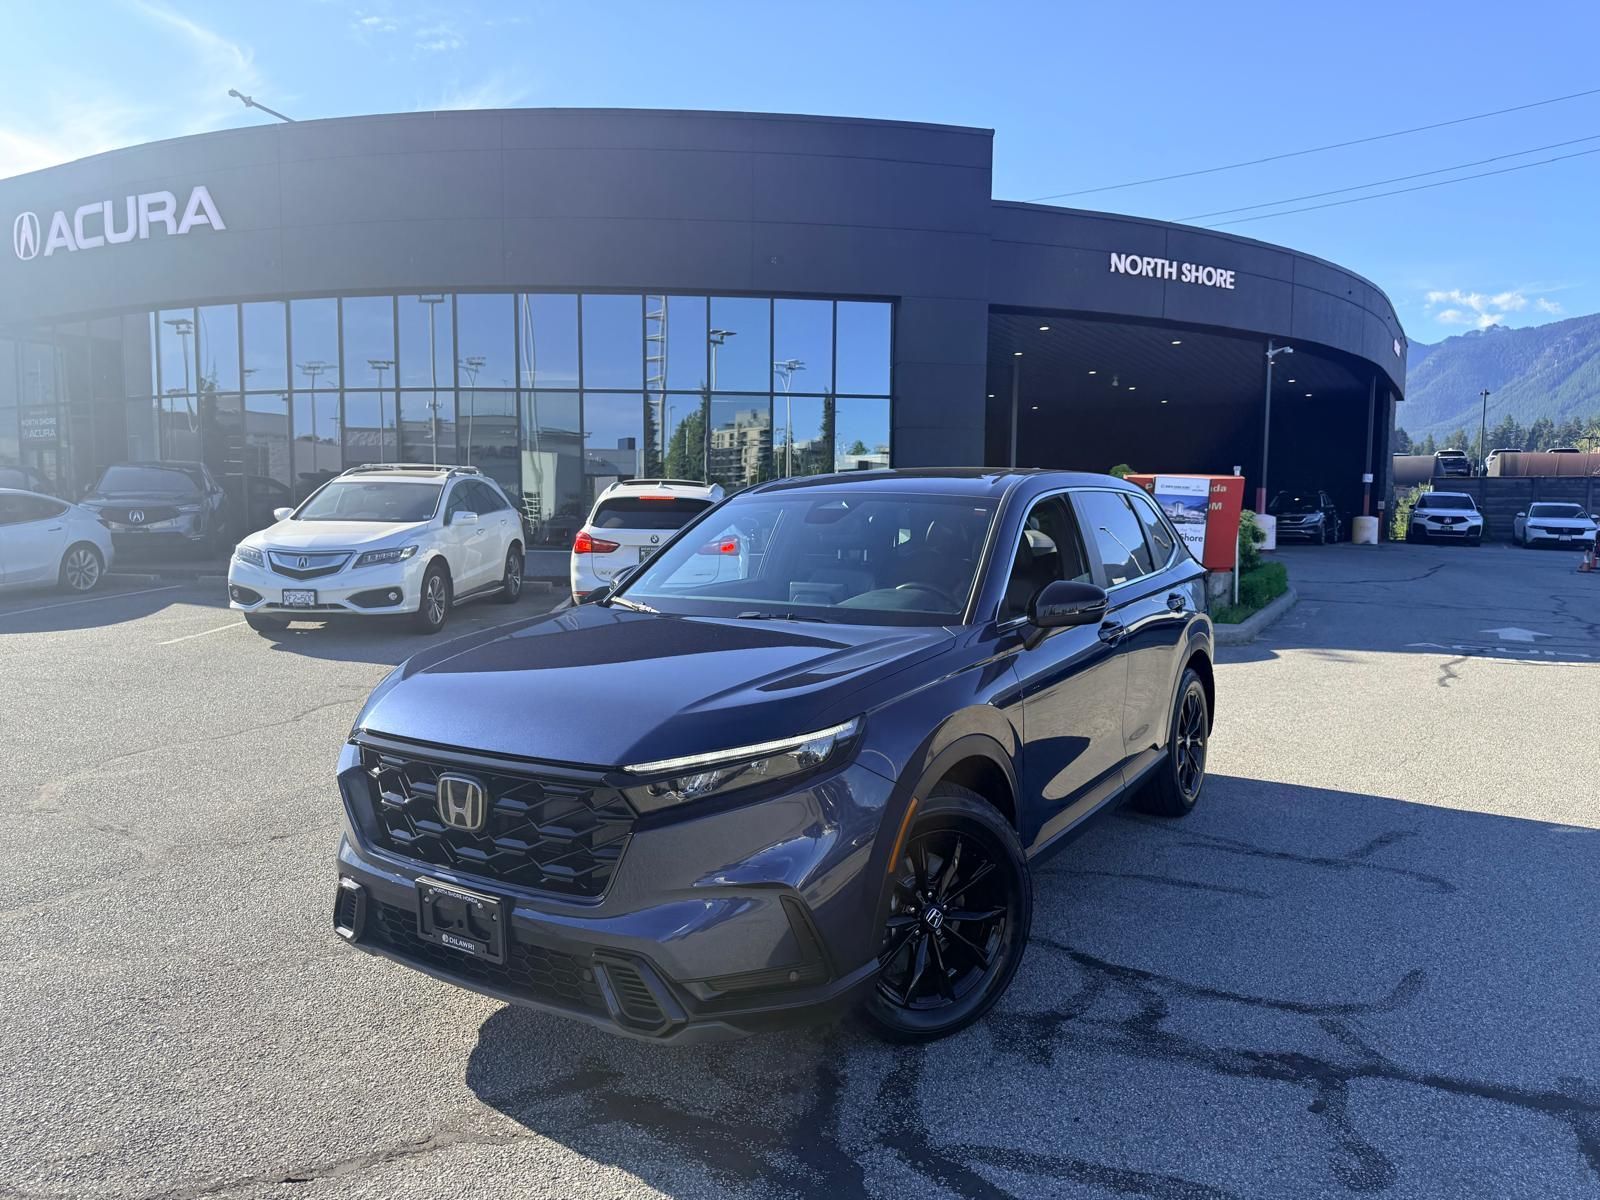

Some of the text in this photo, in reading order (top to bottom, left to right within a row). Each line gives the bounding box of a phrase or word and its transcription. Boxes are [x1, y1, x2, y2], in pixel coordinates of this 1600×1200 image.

[43, 185, 227, 257] ACURA
[1109, 252, 1235, 289] NORTH SHORE
[449, 937, 475, 950] DILAWRI
